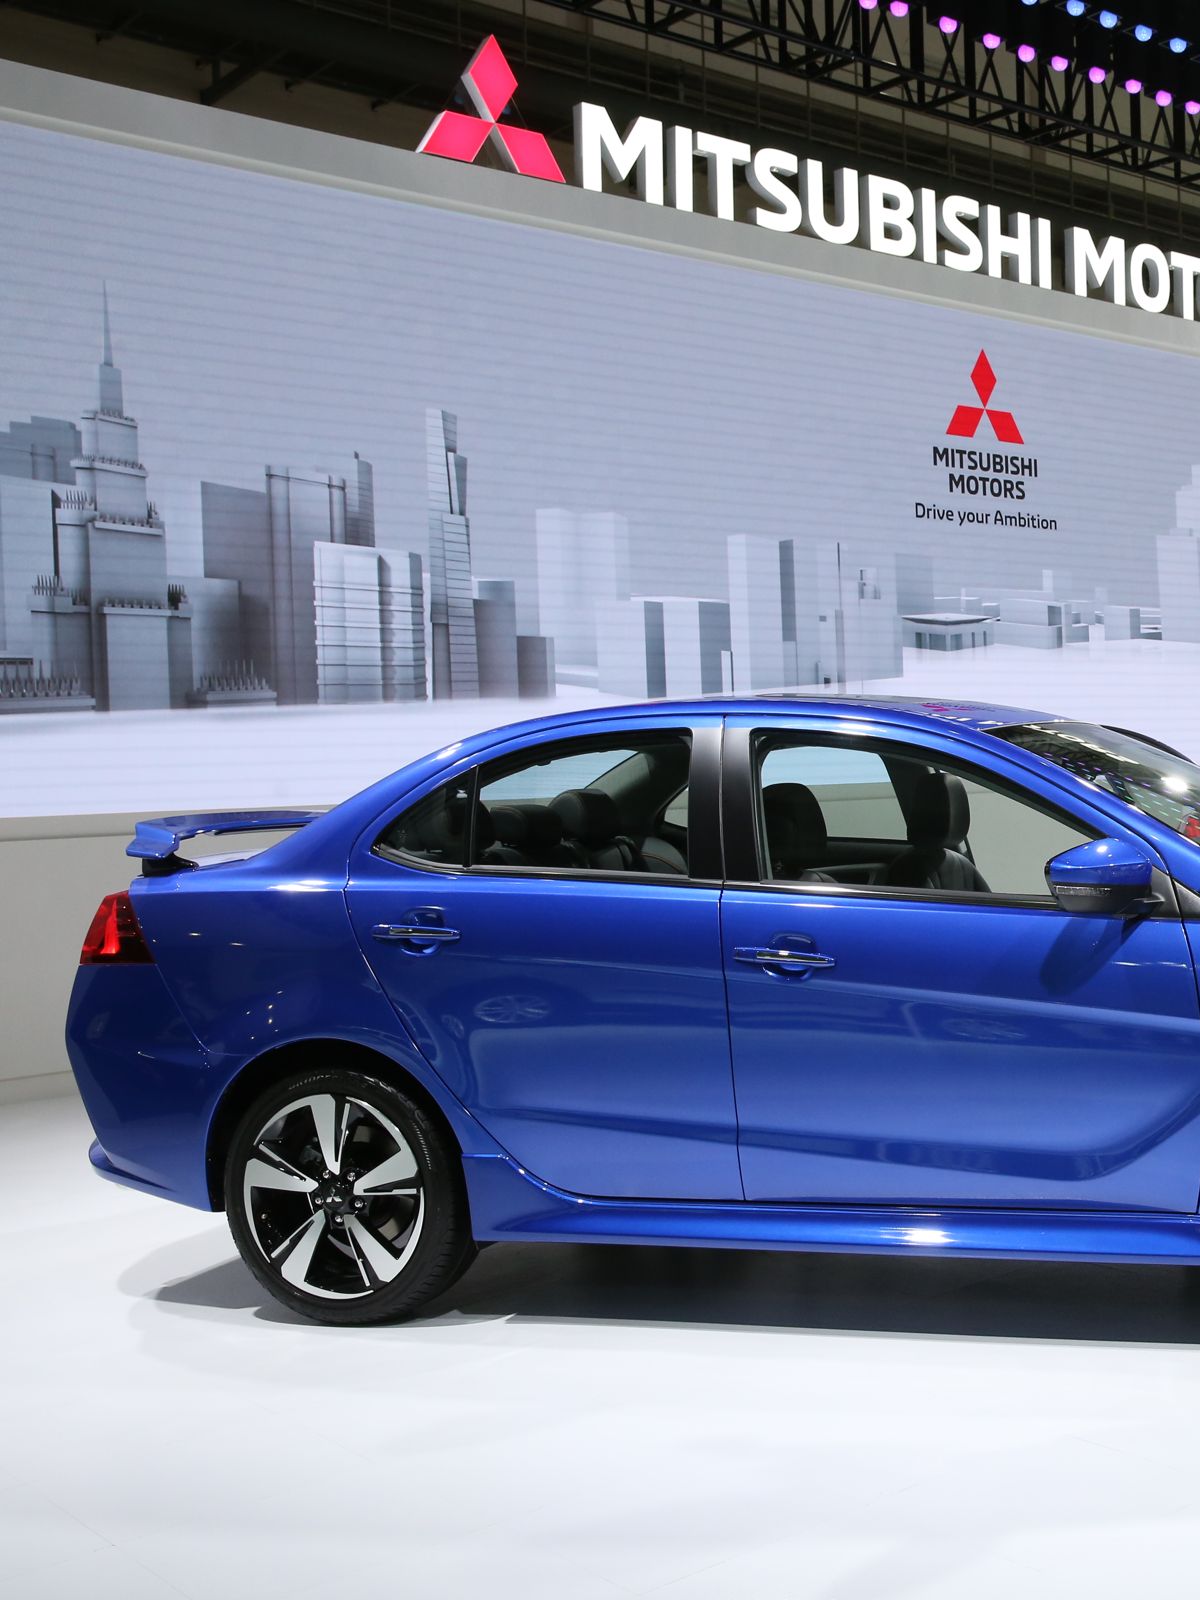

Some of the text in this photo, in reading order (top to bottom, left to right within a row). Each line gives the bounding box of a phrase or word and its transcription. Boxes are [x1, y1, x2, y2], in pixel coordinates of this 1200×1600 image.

[573, 101, 1052, 290] MITSUBISHI
[932, 446, 1038, 478] MITSUBISHI
[949, 473, 1026, 500] MOTORS
[915, 502, 1058, 530] Drive your Ambition
